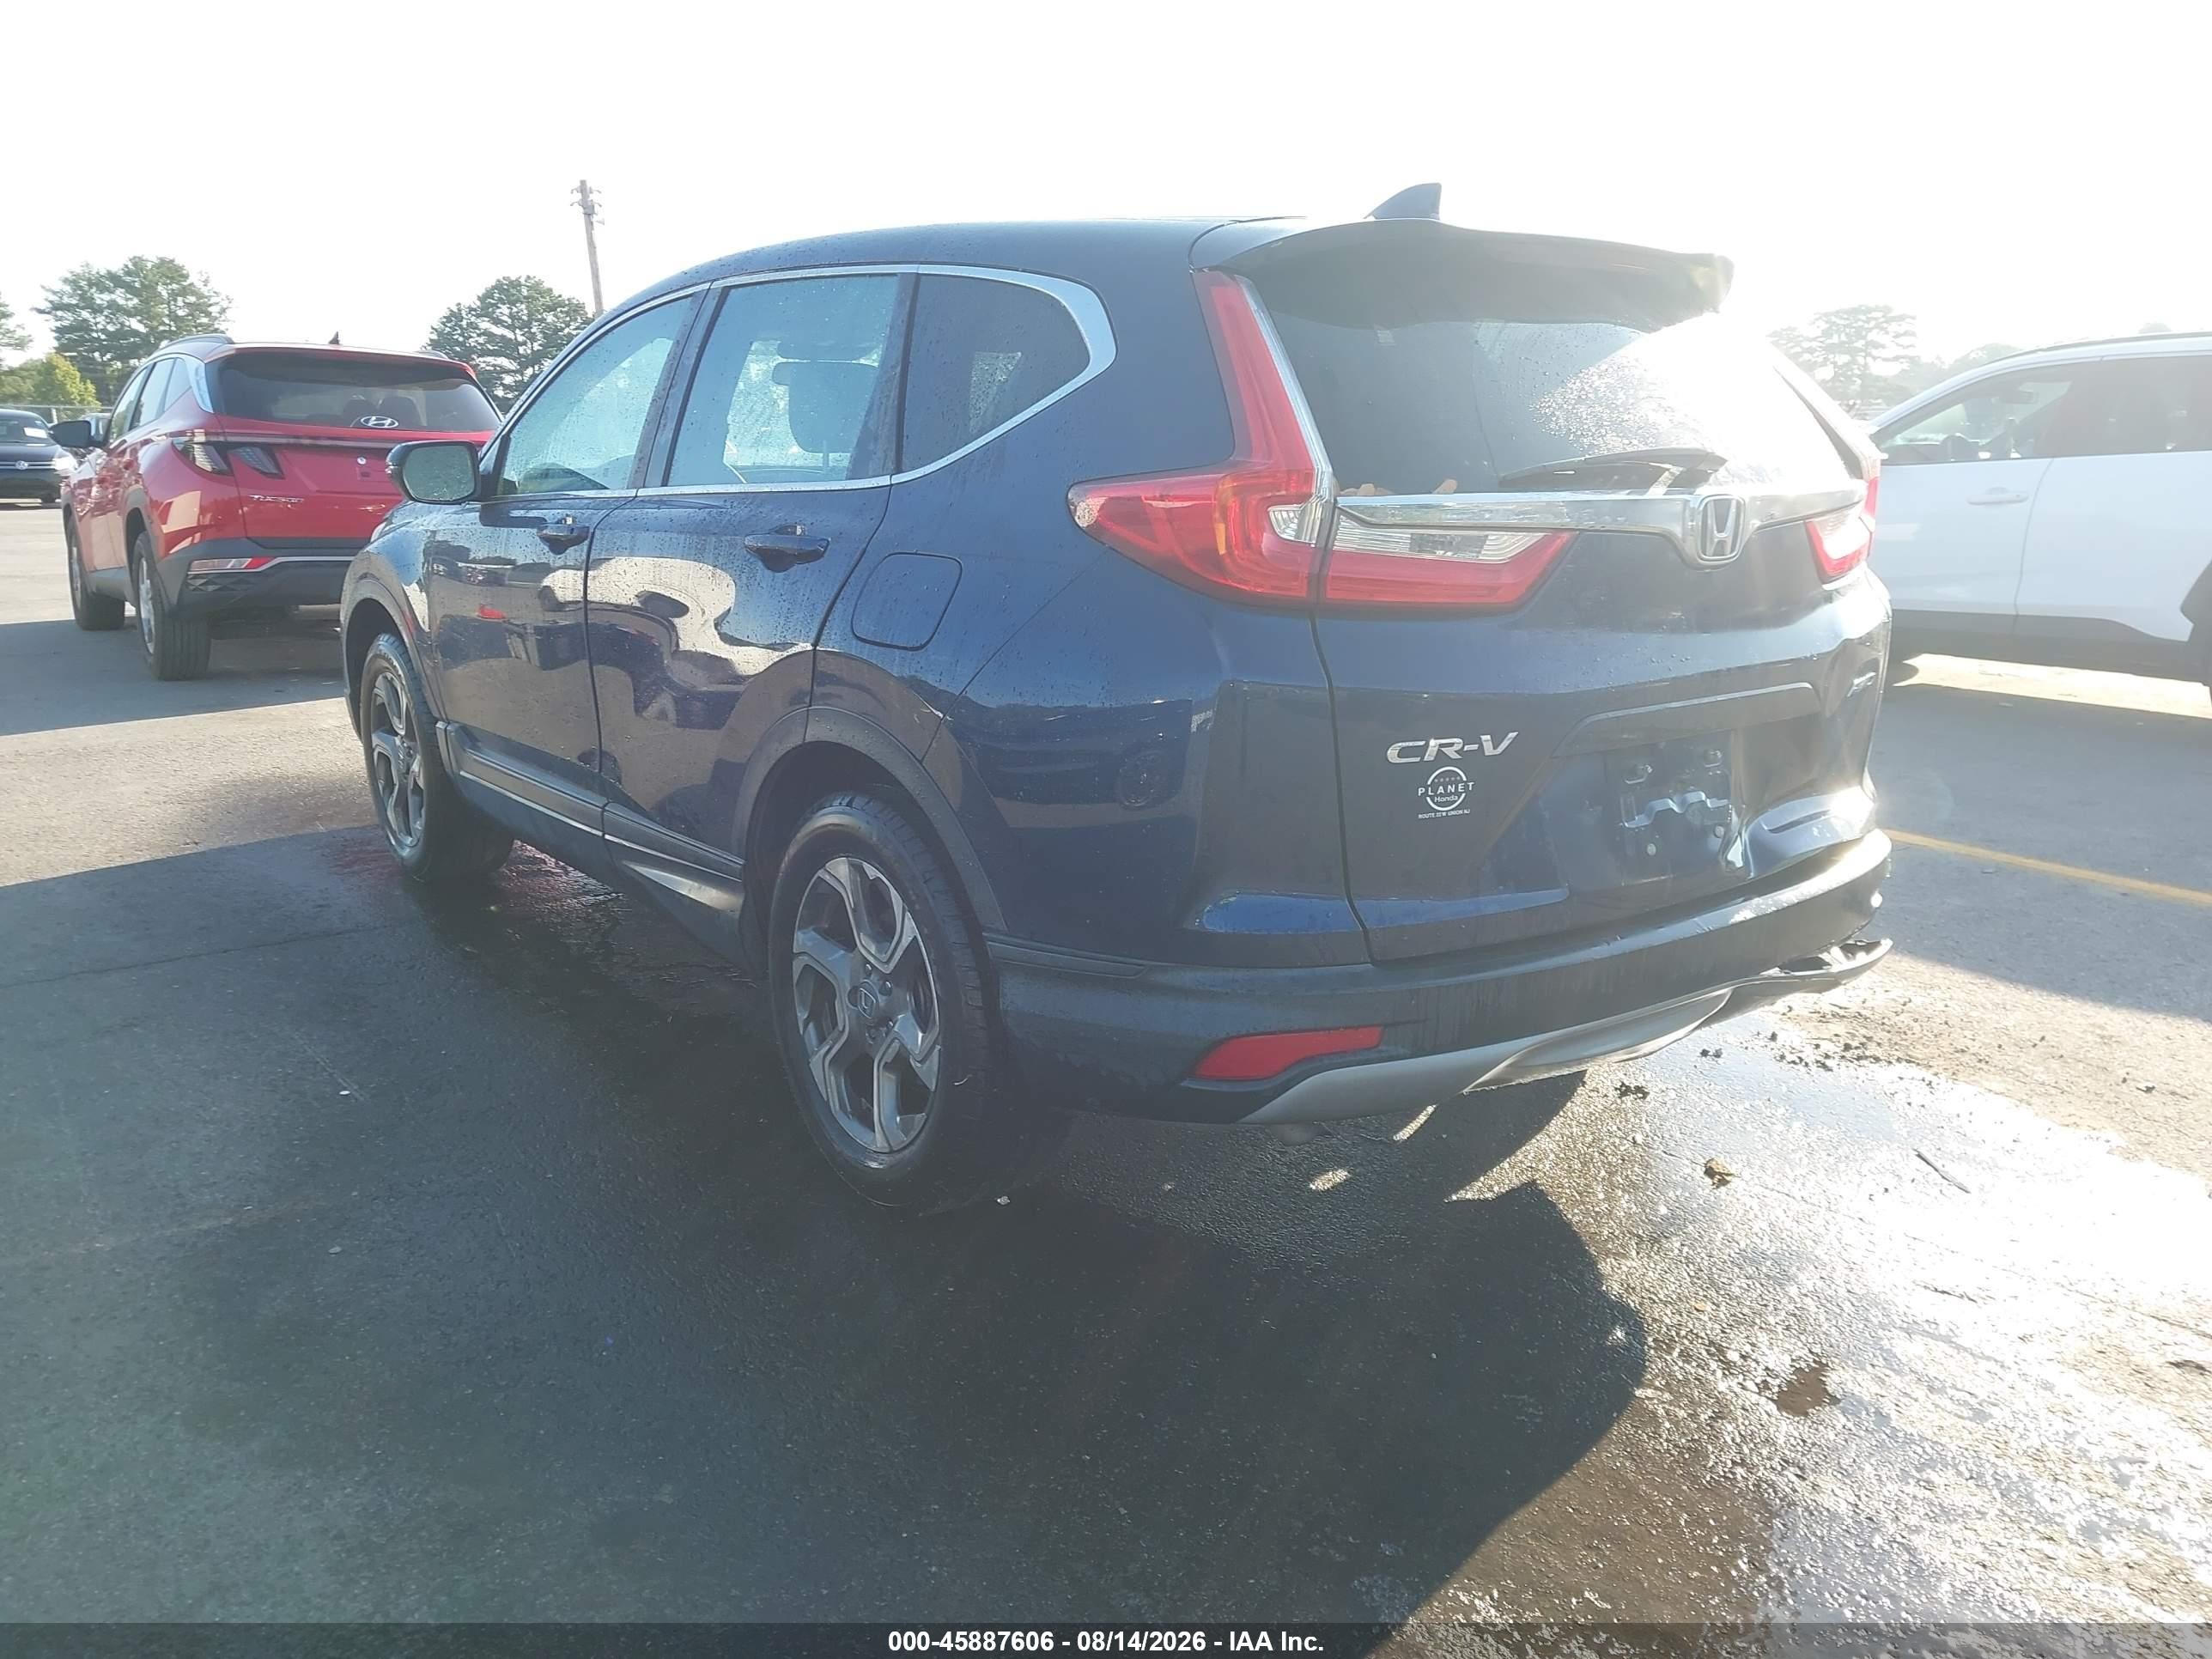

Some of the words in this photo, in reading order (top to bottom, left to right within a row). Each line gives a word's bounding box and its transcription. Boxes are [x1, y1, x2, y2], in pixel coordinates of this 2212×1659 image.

[1386, 731, 1519, 763] CR-V
[1418, 781, 1475, 797] PLANET
[1434, 794, 1458, 803] Honda
